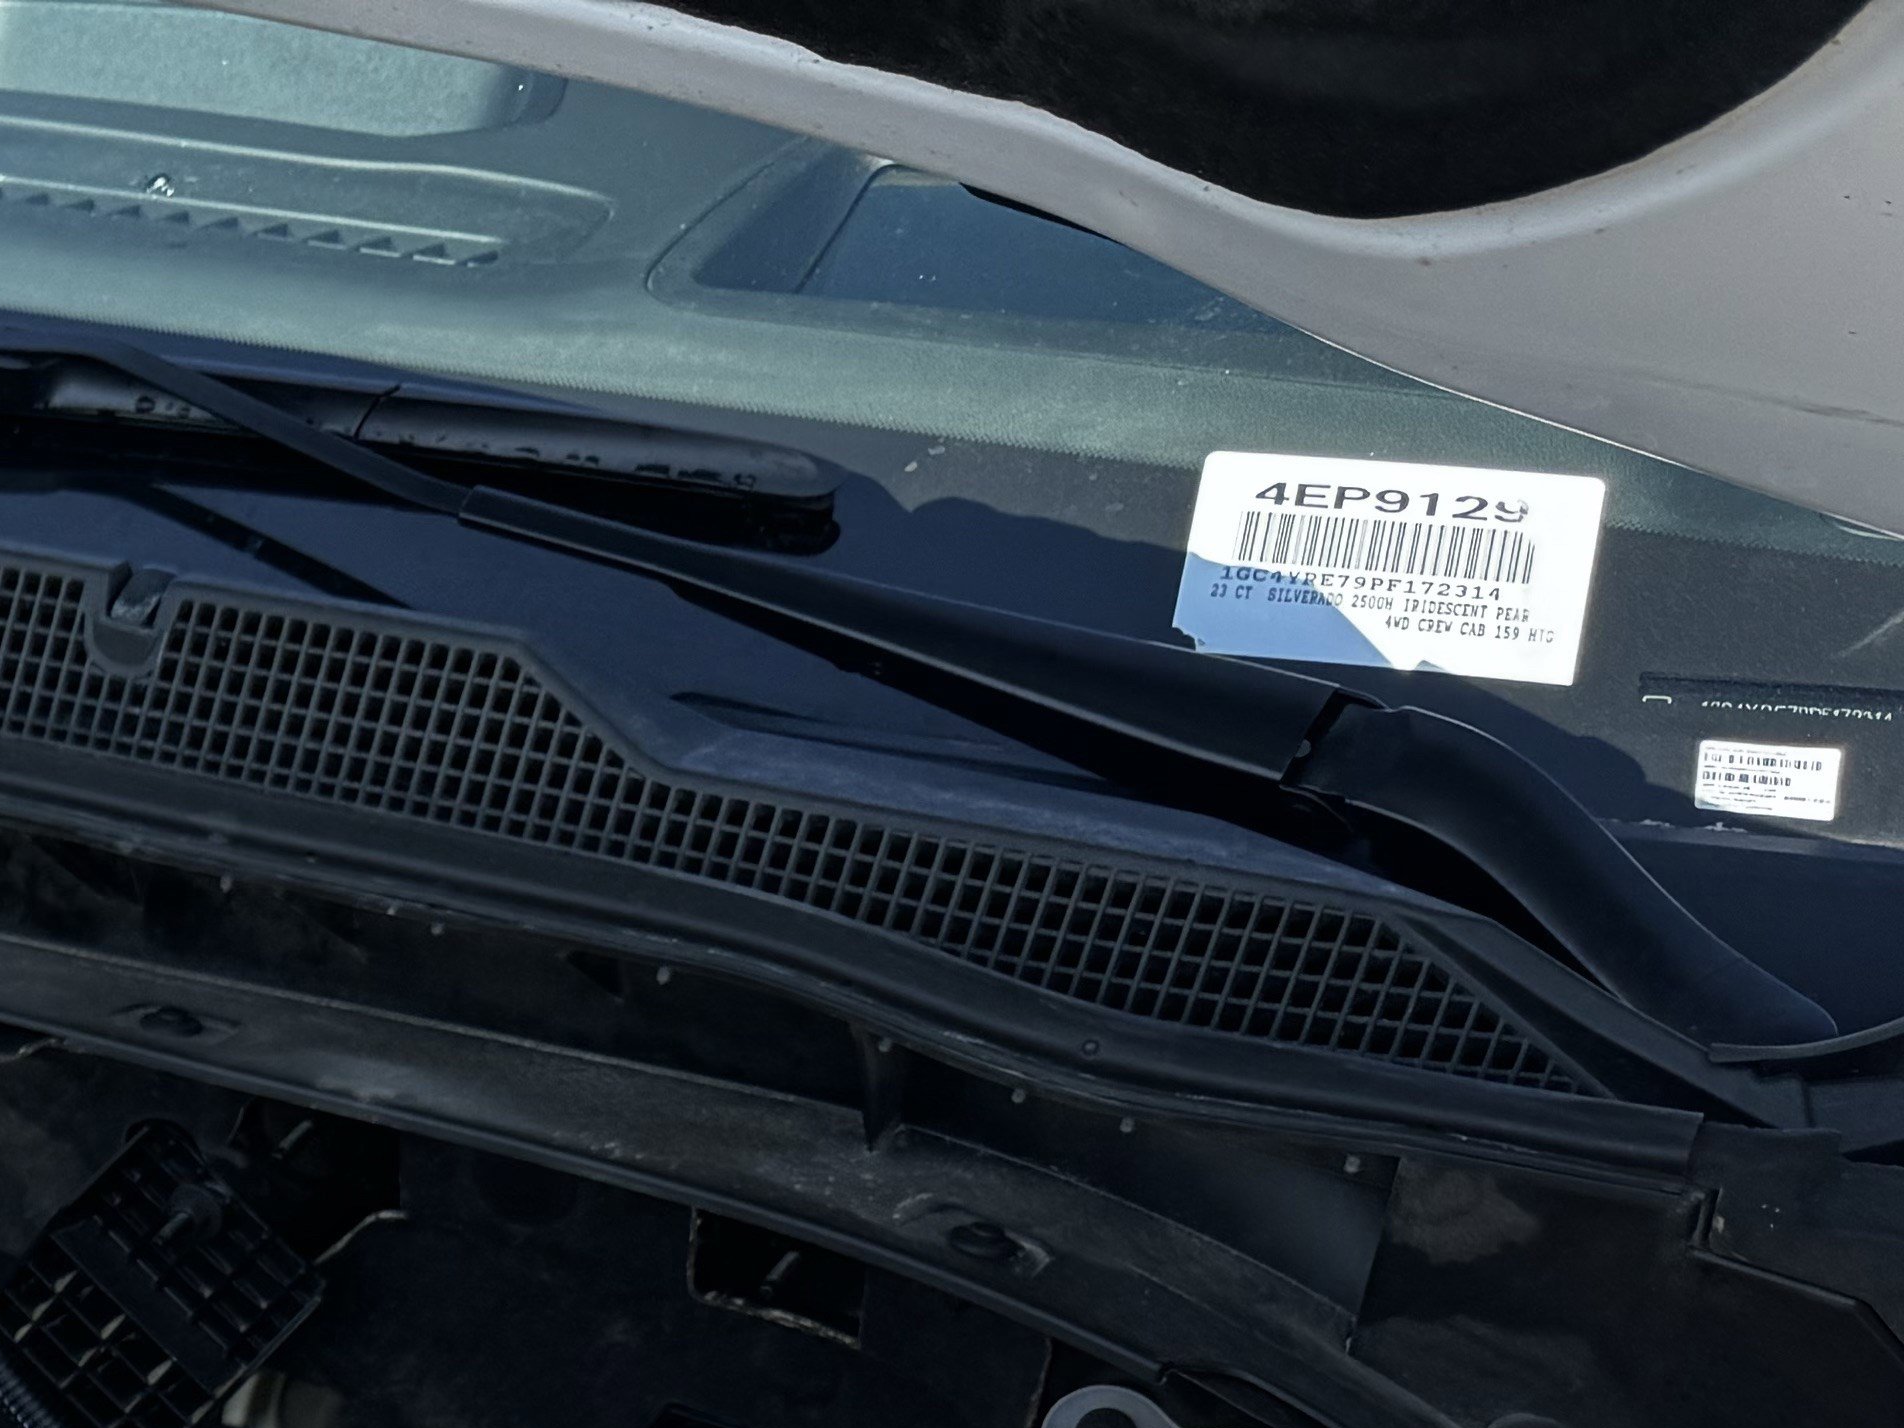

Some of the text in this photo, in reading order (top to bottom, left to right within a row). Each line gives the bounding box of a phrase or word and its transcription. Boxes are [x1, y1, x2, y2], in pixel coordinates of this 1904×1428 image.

[1255, 482, 1530, 523] 4EP9129
[1210, 583, 1530, 622] 23 CT SILVERADO 2500H IRIDESCENT PEAR
[1385, 615, 1409, 630] 4WD
[1418, 618, 1452, 633] CREW
[1460, 622, 1485, 637] CAB
[1495, 625, 1520, 640] 159
